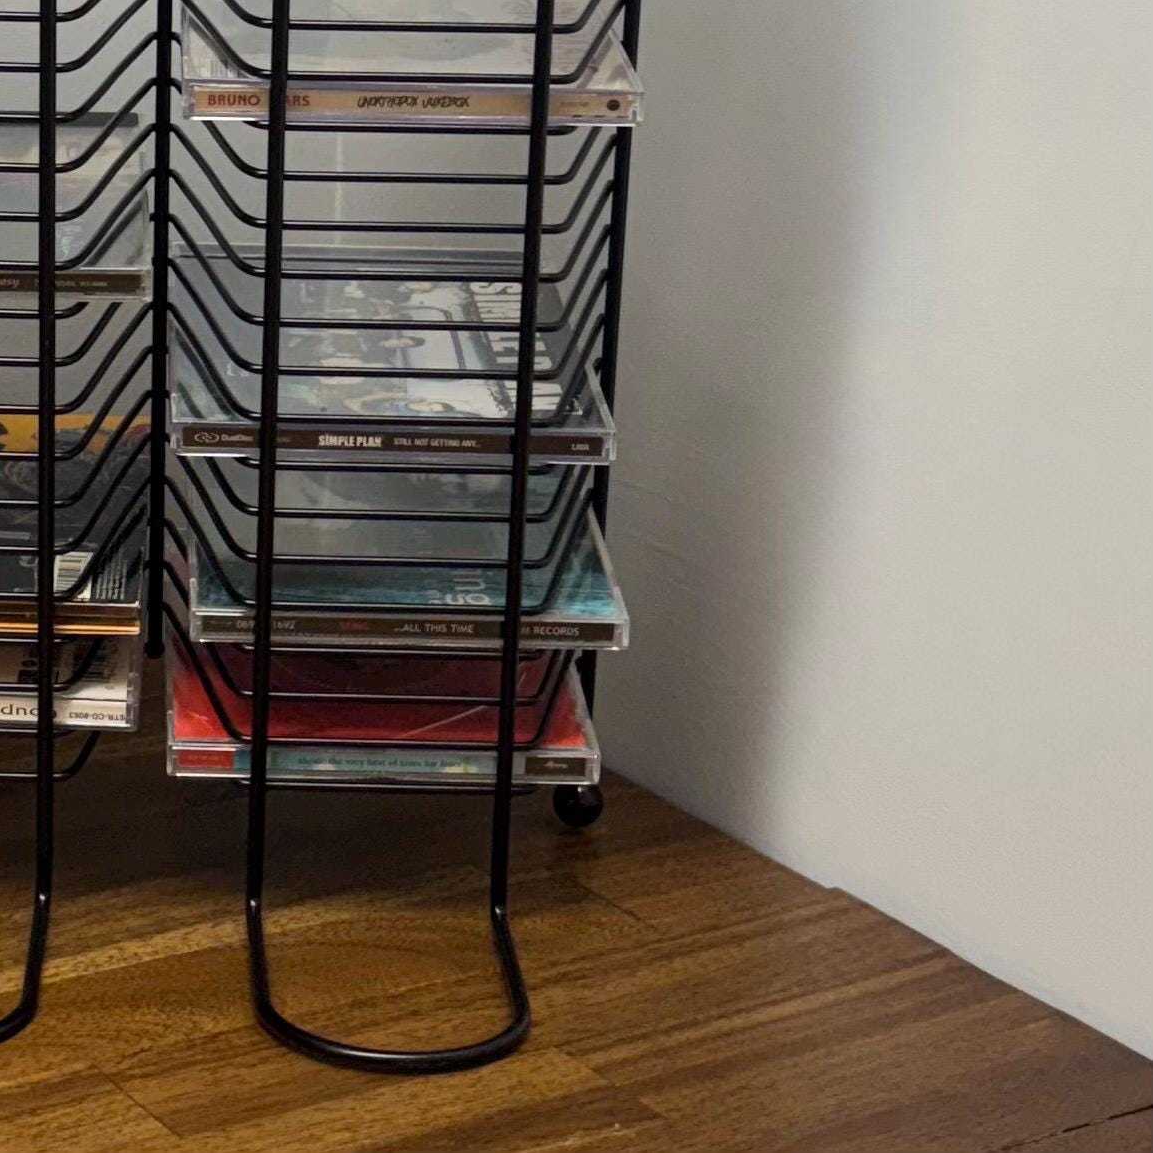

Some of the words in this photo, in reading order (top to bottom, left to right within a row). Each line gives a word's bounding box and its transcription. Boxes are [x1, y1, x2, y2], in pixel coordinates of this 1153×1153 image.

[207, 94, 261, 107] BRUNO
[318, 434, 355, 447] SIMPLE
[356, 436, 382, 447] PLAN
[424, 623, 448, 633] THIS
[450, 624, 475, 634] TIME
[533, 625, 581, 636] RECORDS
